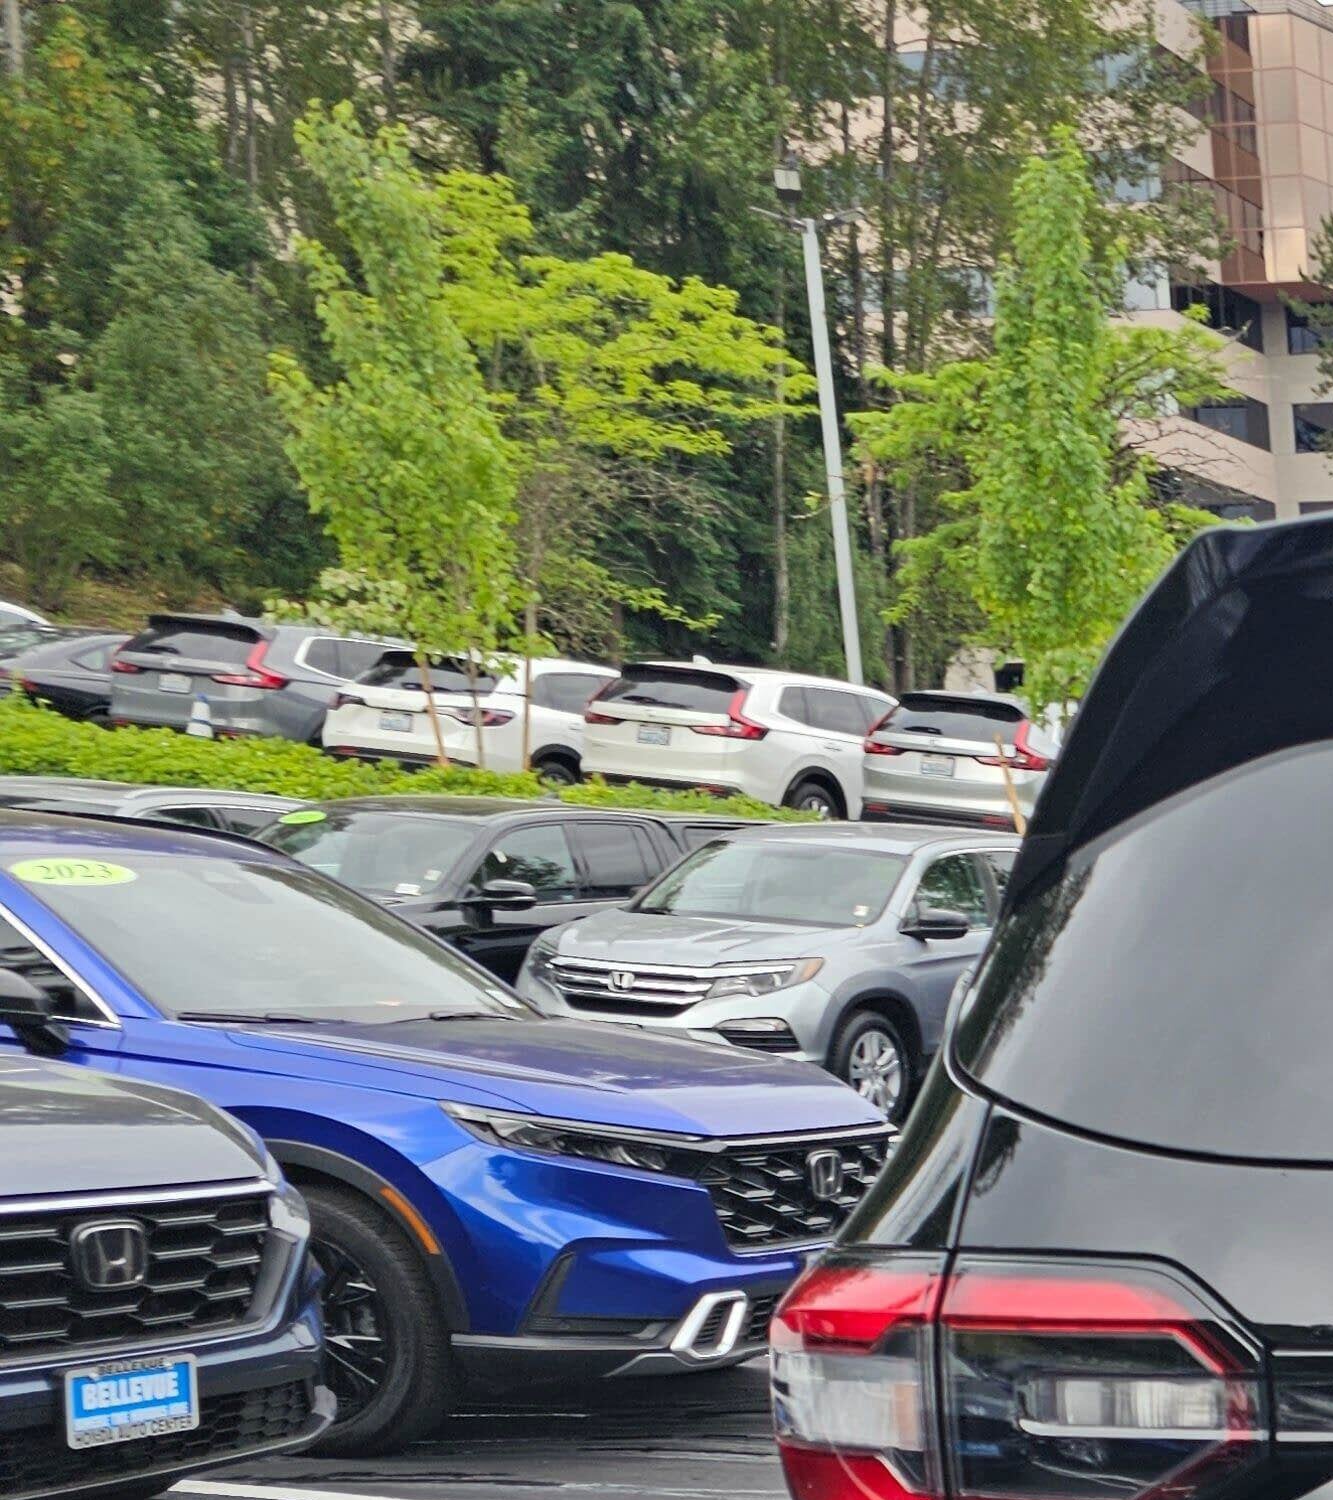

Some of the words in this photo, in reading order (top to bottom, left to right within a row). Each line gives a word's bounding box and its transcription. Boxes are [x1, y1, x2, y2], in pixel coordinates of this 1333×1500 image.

[31, 863, 113, 880] 2023
[81, 1371, 179, 1411] BELLEVUE
[149, 1414, 193, 1434] CENTER
